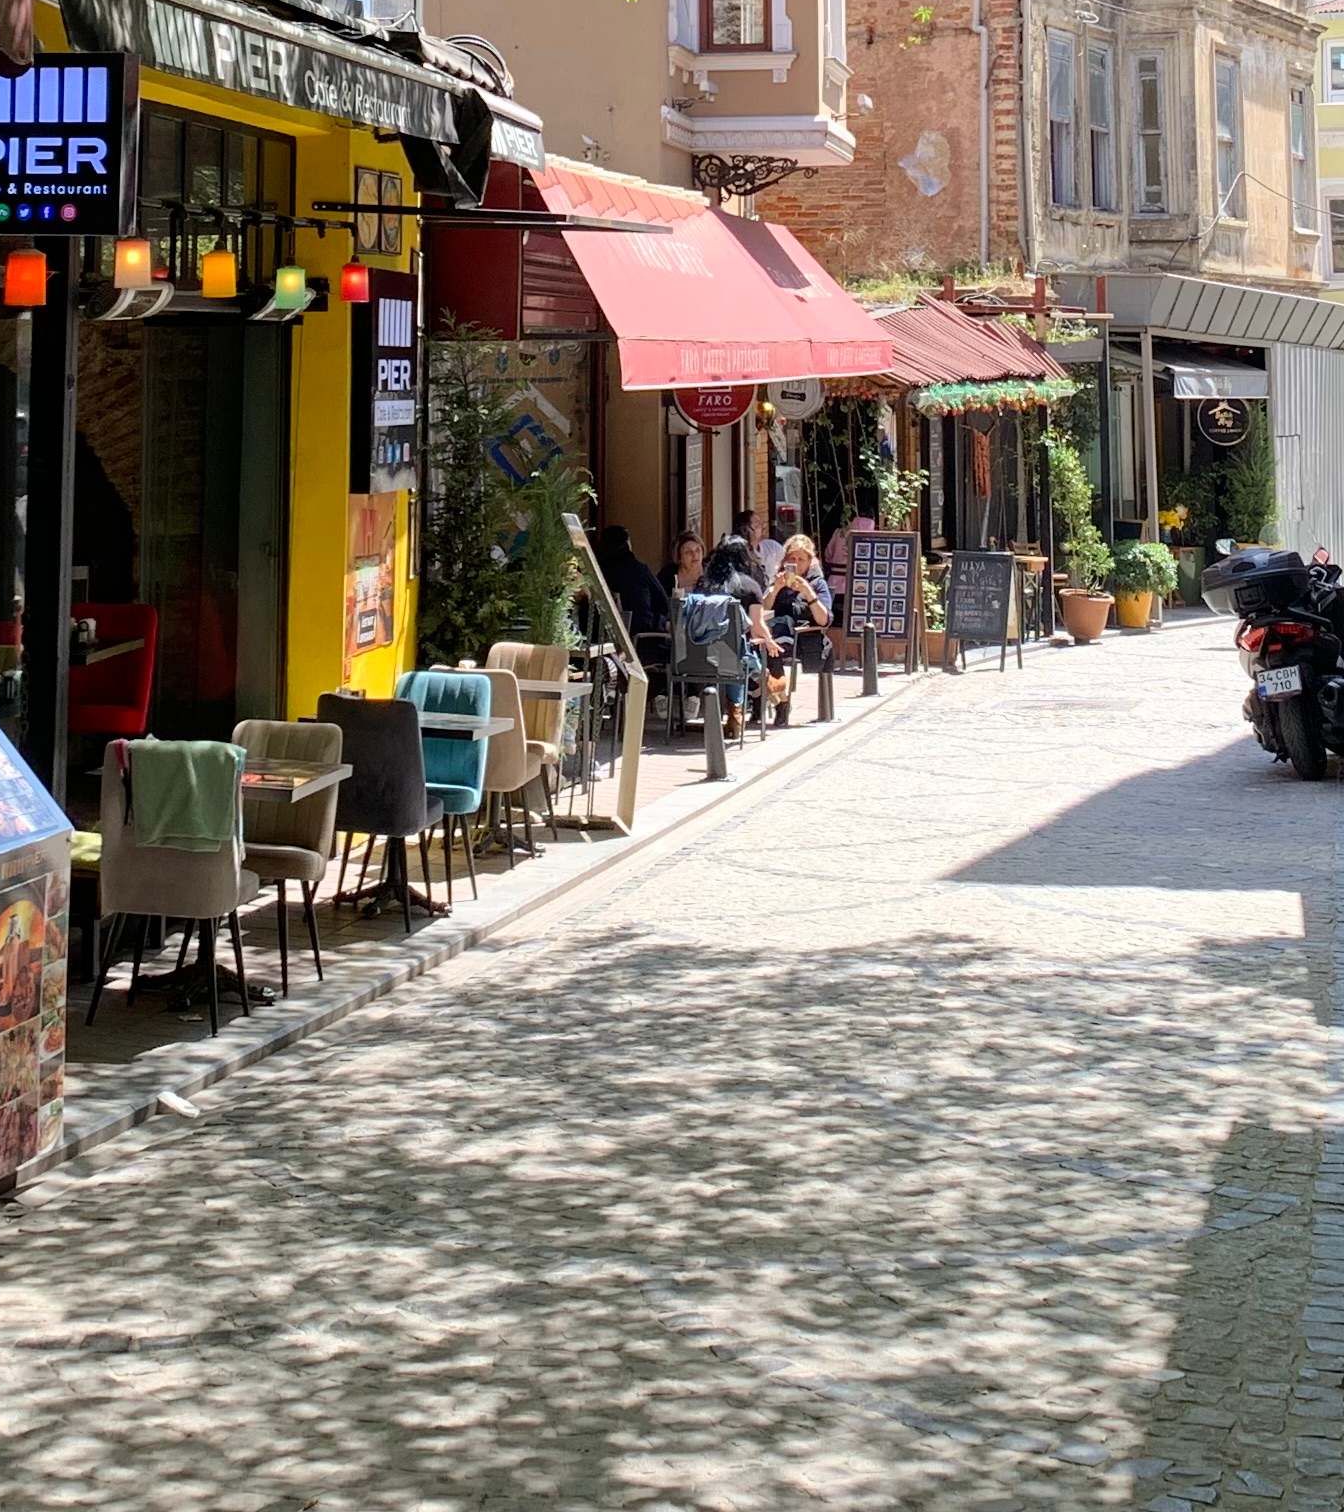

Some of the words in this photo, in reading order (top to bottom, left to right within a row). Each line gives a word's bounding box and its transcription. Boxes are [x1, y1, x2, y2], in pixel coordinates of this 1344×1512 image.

[210, 21, 293, 105] PIER
[340, 80, 353, 113] &
[356, 83, 411, 127] Restaurant
[504, 124, 539, 158] PIER
[7, 183, 18, 195] &
[23, 182, 107, 195] Restaurant
[377, 359, 412, 390] PIER
[698, 395, 732, 406] FARO
[1258, 673, 1273, 683] 34
[1276, 668, 1297, 680] CBH
[1272, 680, 1292, 692] 710
